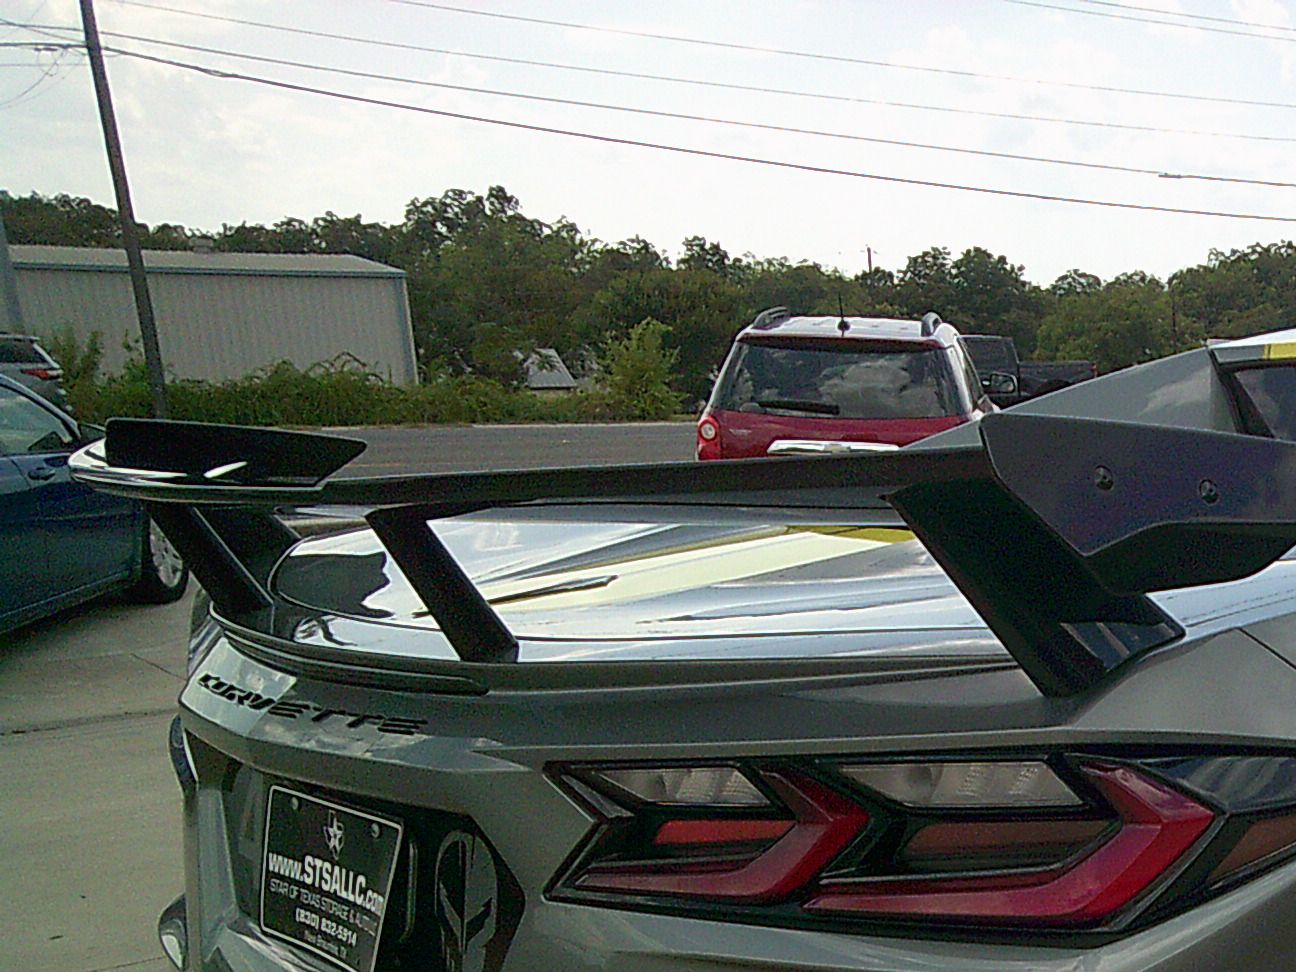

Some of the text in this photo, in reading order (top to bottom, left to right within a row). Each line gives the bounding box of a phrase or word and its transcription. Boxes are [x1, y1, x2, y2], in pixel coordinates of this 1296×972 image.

[199, 675, 427, 734] CORVETTE
[270, 878, 289, 895] STAR
[289, 885, 299, 899] OF
